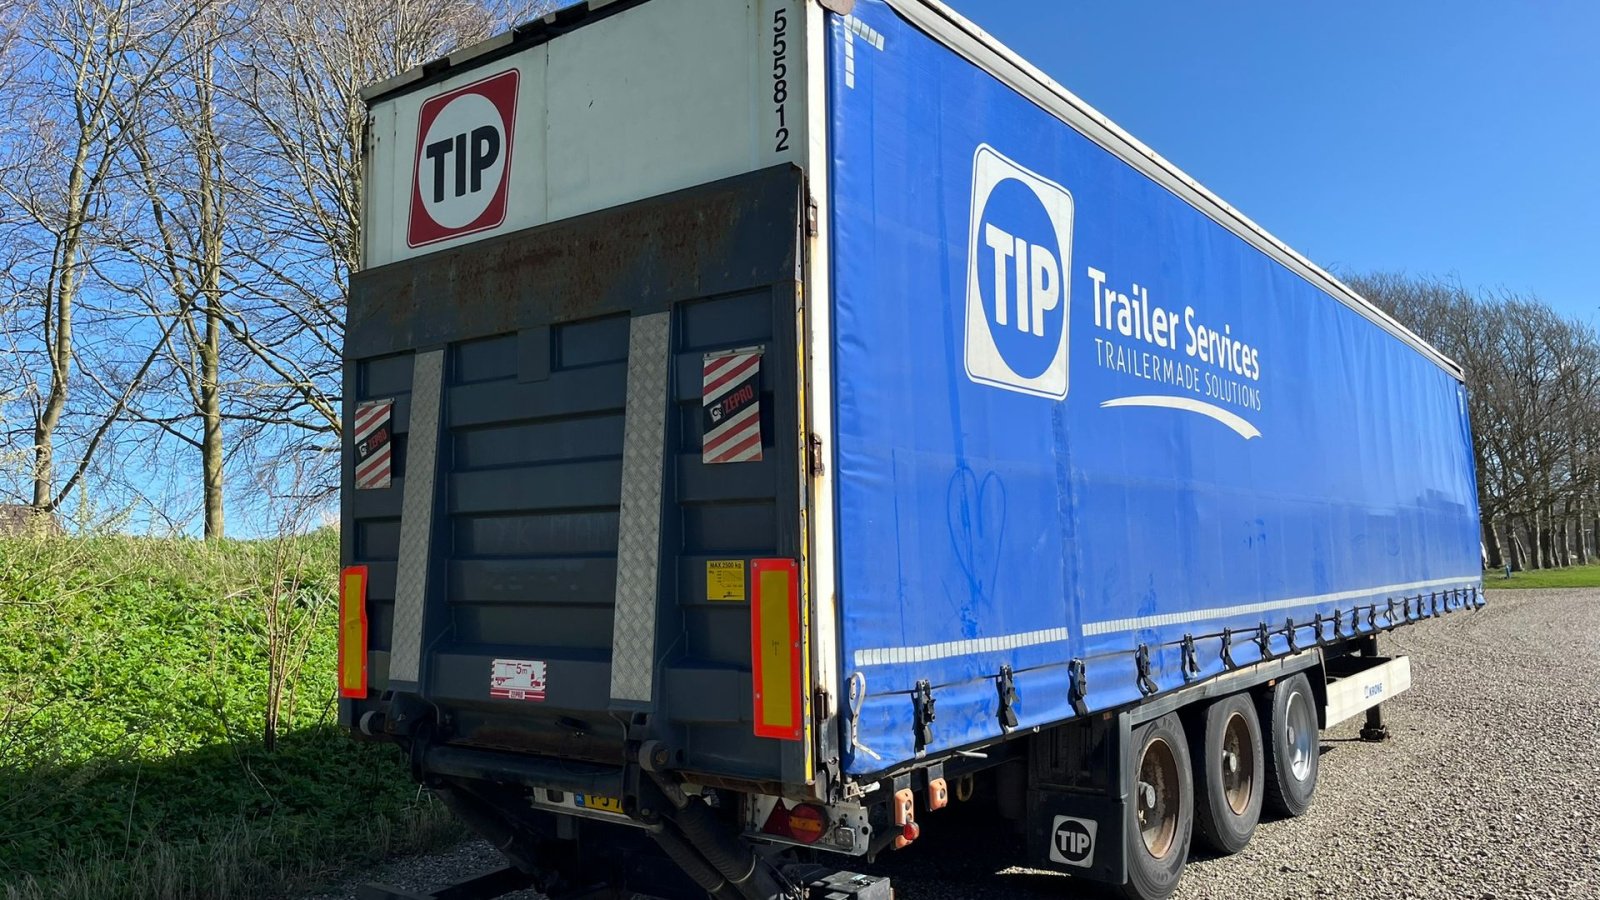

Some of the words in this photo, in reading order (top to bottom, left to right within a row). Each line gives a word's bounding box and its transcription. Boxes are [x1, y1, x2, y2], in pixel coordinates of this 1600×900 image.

[772, 8, 789, 152] 555812
[426, 124, 501, 204] TIP
[985, 221, 1060, 337] TIP
[1087, 266, 1180, 351] Trailer
[1184, 305, 1260, 381] Services
[722, 384, 755, 415] ZEPRO
[1094, 337, 1201, 393] TRAILERMADE
[1204, 371, 1262, 412] SOLUTIONS
[368, 428, 387, 450] ZEPRO
[1369, 682, 1383, 696] KRONE
[1057, 829, 1091, 855] TIP
